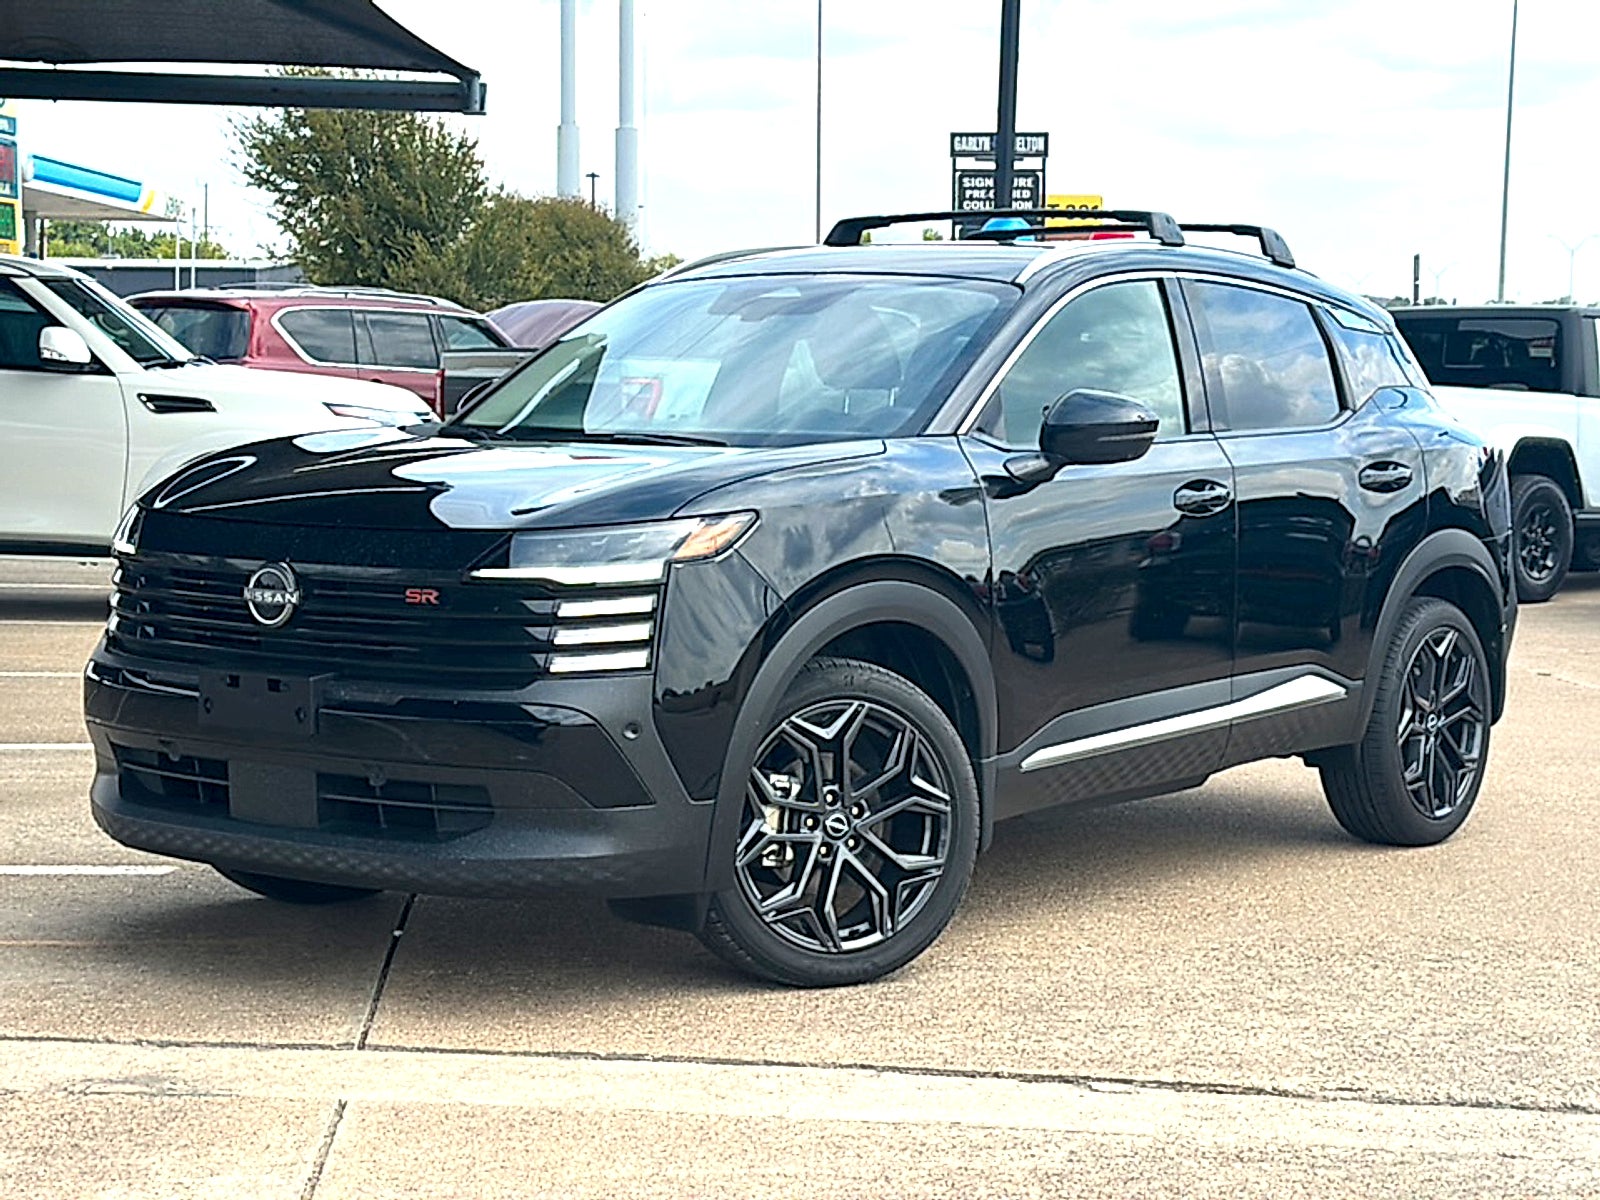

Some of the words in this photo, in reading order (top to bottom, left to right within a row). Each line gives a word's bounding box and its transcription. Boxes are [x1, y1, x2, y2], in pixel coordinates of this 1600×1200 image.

[962, 177, 1034, 188] SIGNURE
[244, 587, 299, 604] NISSAN
[405, 588, 440, 604] SR
